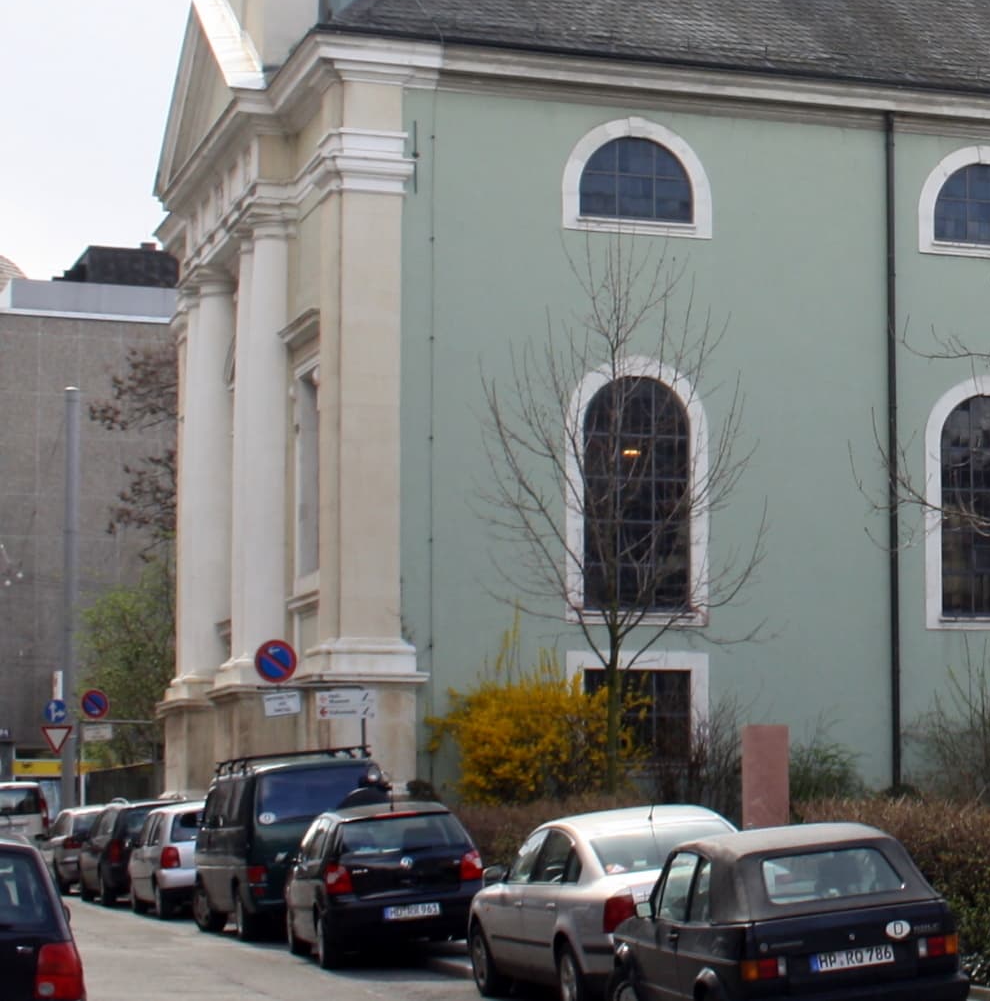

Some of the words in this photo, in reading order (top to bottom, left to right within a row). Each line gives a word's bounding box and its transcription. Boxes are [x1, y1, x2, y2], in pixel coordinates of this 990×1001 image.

[893, 922, 904, 936] D
[818, 952, 837, 968] HP
[868, 947, 893, 962] 786
